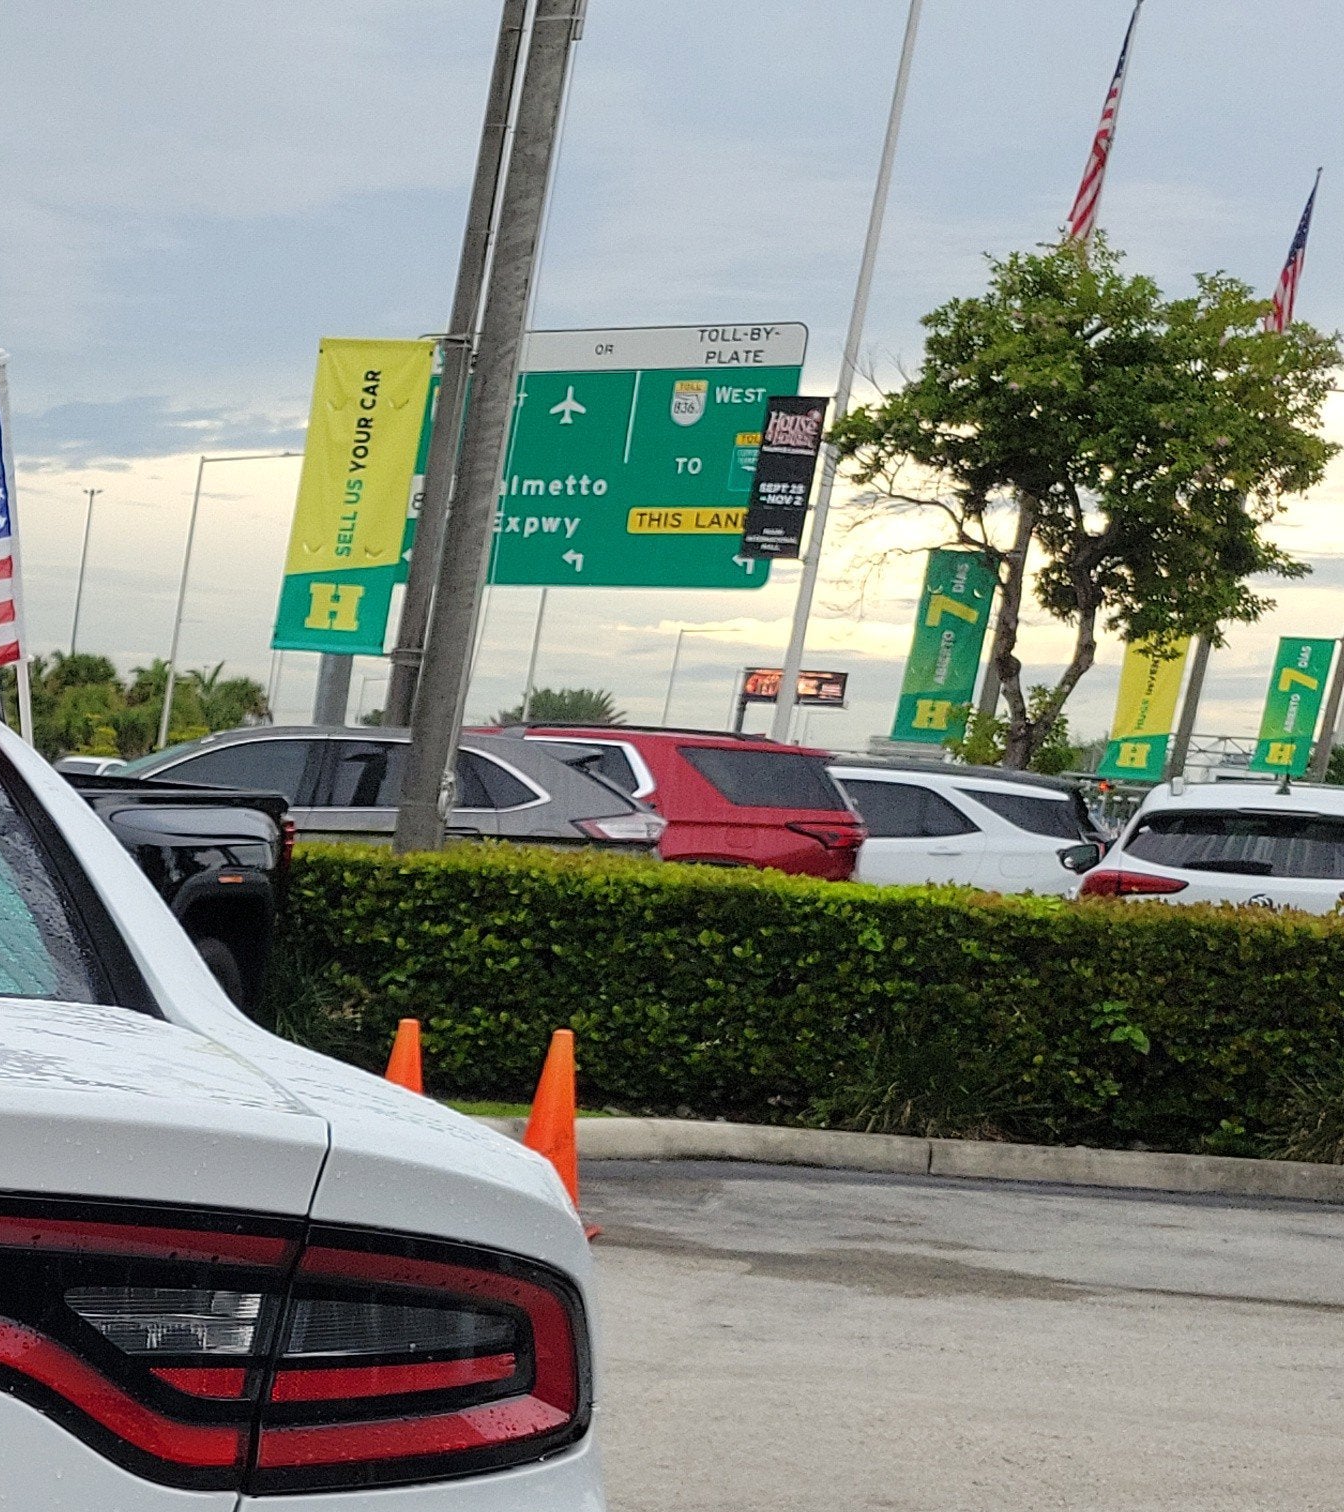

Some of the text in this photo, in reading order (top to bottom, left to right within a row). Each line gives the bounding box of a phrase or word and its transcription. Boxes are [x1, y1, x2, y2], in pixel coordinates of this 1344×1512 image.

[698, 326, 782, 343] TOLL-BY-
[595, 343, 615, 356] OR
[705, 349, 765, 364] PLATE
[715, 385, 767, 404] WEST
[334, 368, 382, 557] SELL US YOUR CAR
[675, 457, 703, 475] TO
[497, 474, 608, 496] almetto
[636, 511, 746, 529] THIS LAN
[925, 594, 980, 627] 7
[1278, 667, 1319, 692] 7
